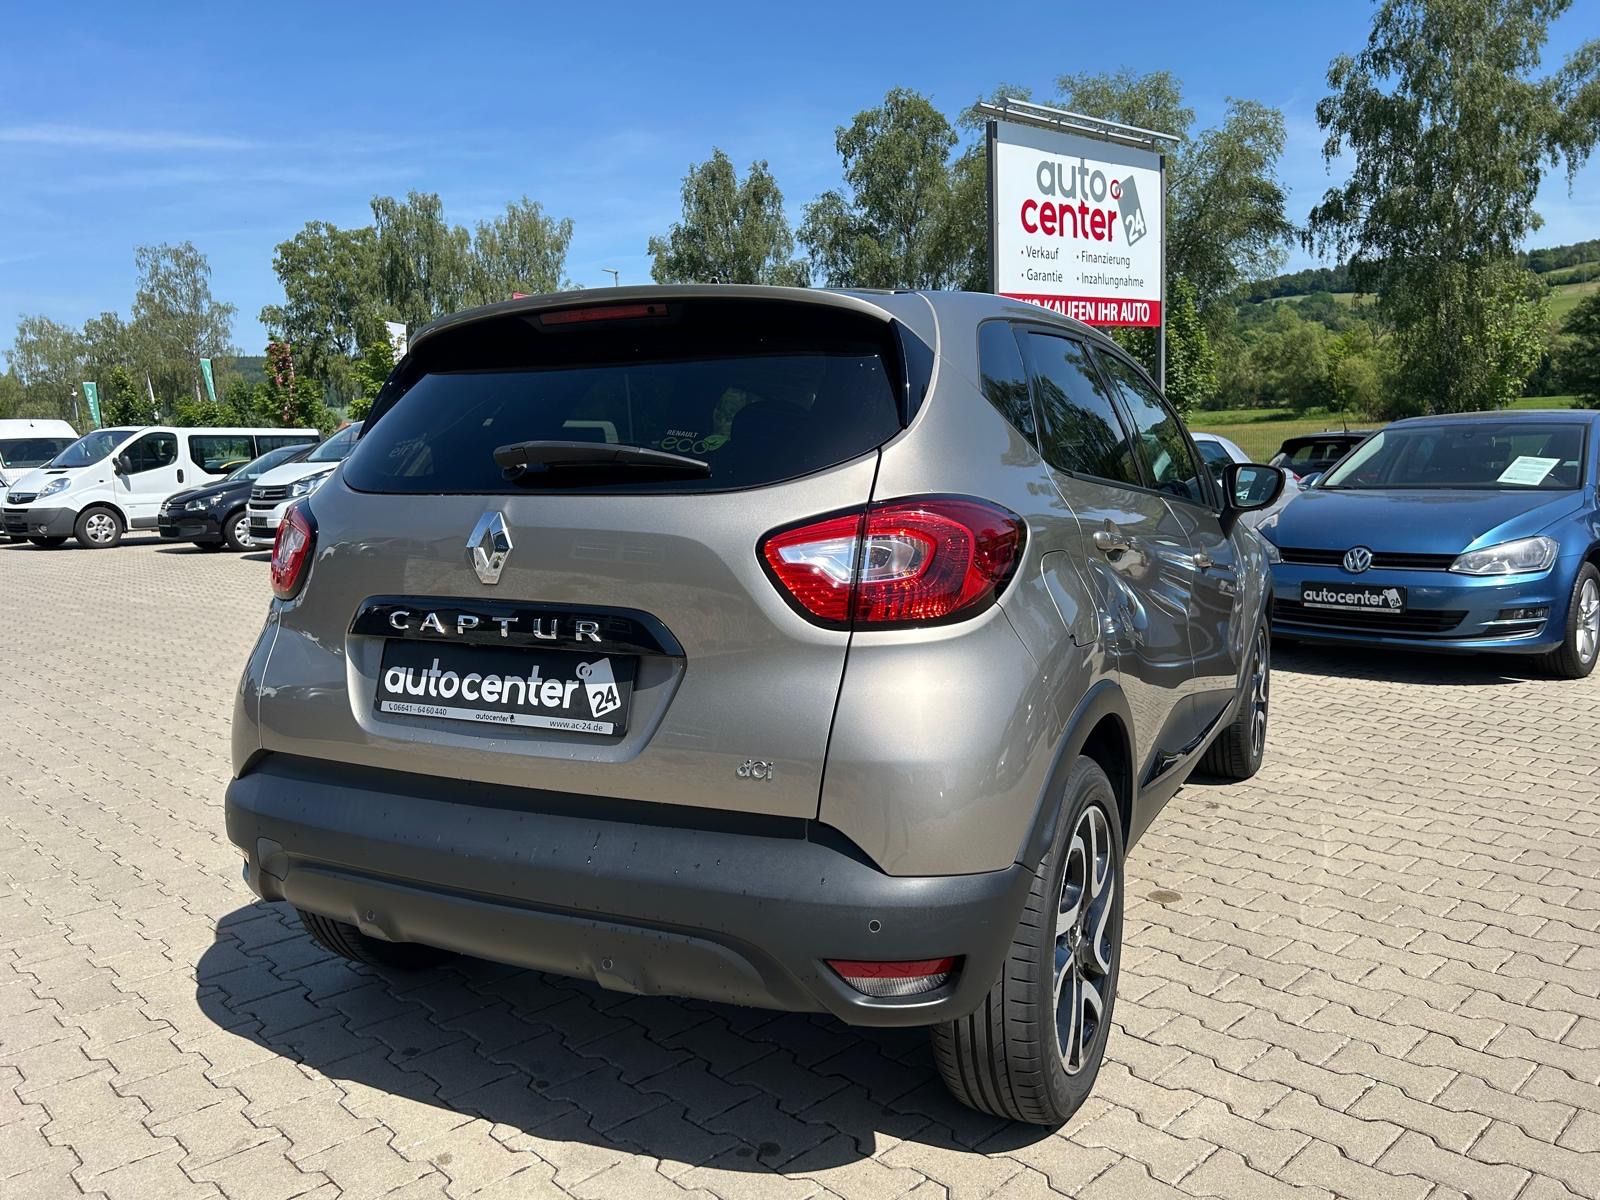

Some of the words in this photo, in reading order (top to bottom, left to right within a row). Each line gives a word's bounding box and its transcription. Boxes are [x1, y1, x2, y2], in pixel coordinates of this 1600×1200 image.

[1036, 158, 1107, 203] auto
[1020, 199, 1117, 242] center
[1124, 208, 1145, 240] 24
[1025, 245, 1059, 260] Verkauf
[1081, 250, 1131, 269] Finanzierung
[1026, 268, 1063, 283] Garantie
[1081, 272, 1144, 288] Inzahlungnahme
[1097, 302, 1118, 322] IHR
[1120, 302, 1151, 322] AUTO
[666, 429, 699, 439] RENAULT
[1303, 587, 1385, 606] autocenter
[388, 610, 602, 643] CAPTUR
[384, 657, 580, 709] autocenter
[592, 685, 617, 714] 24
[475, 712, 509, 723] autocenter
[549, 719, 604, 732] www.ac-24.de
